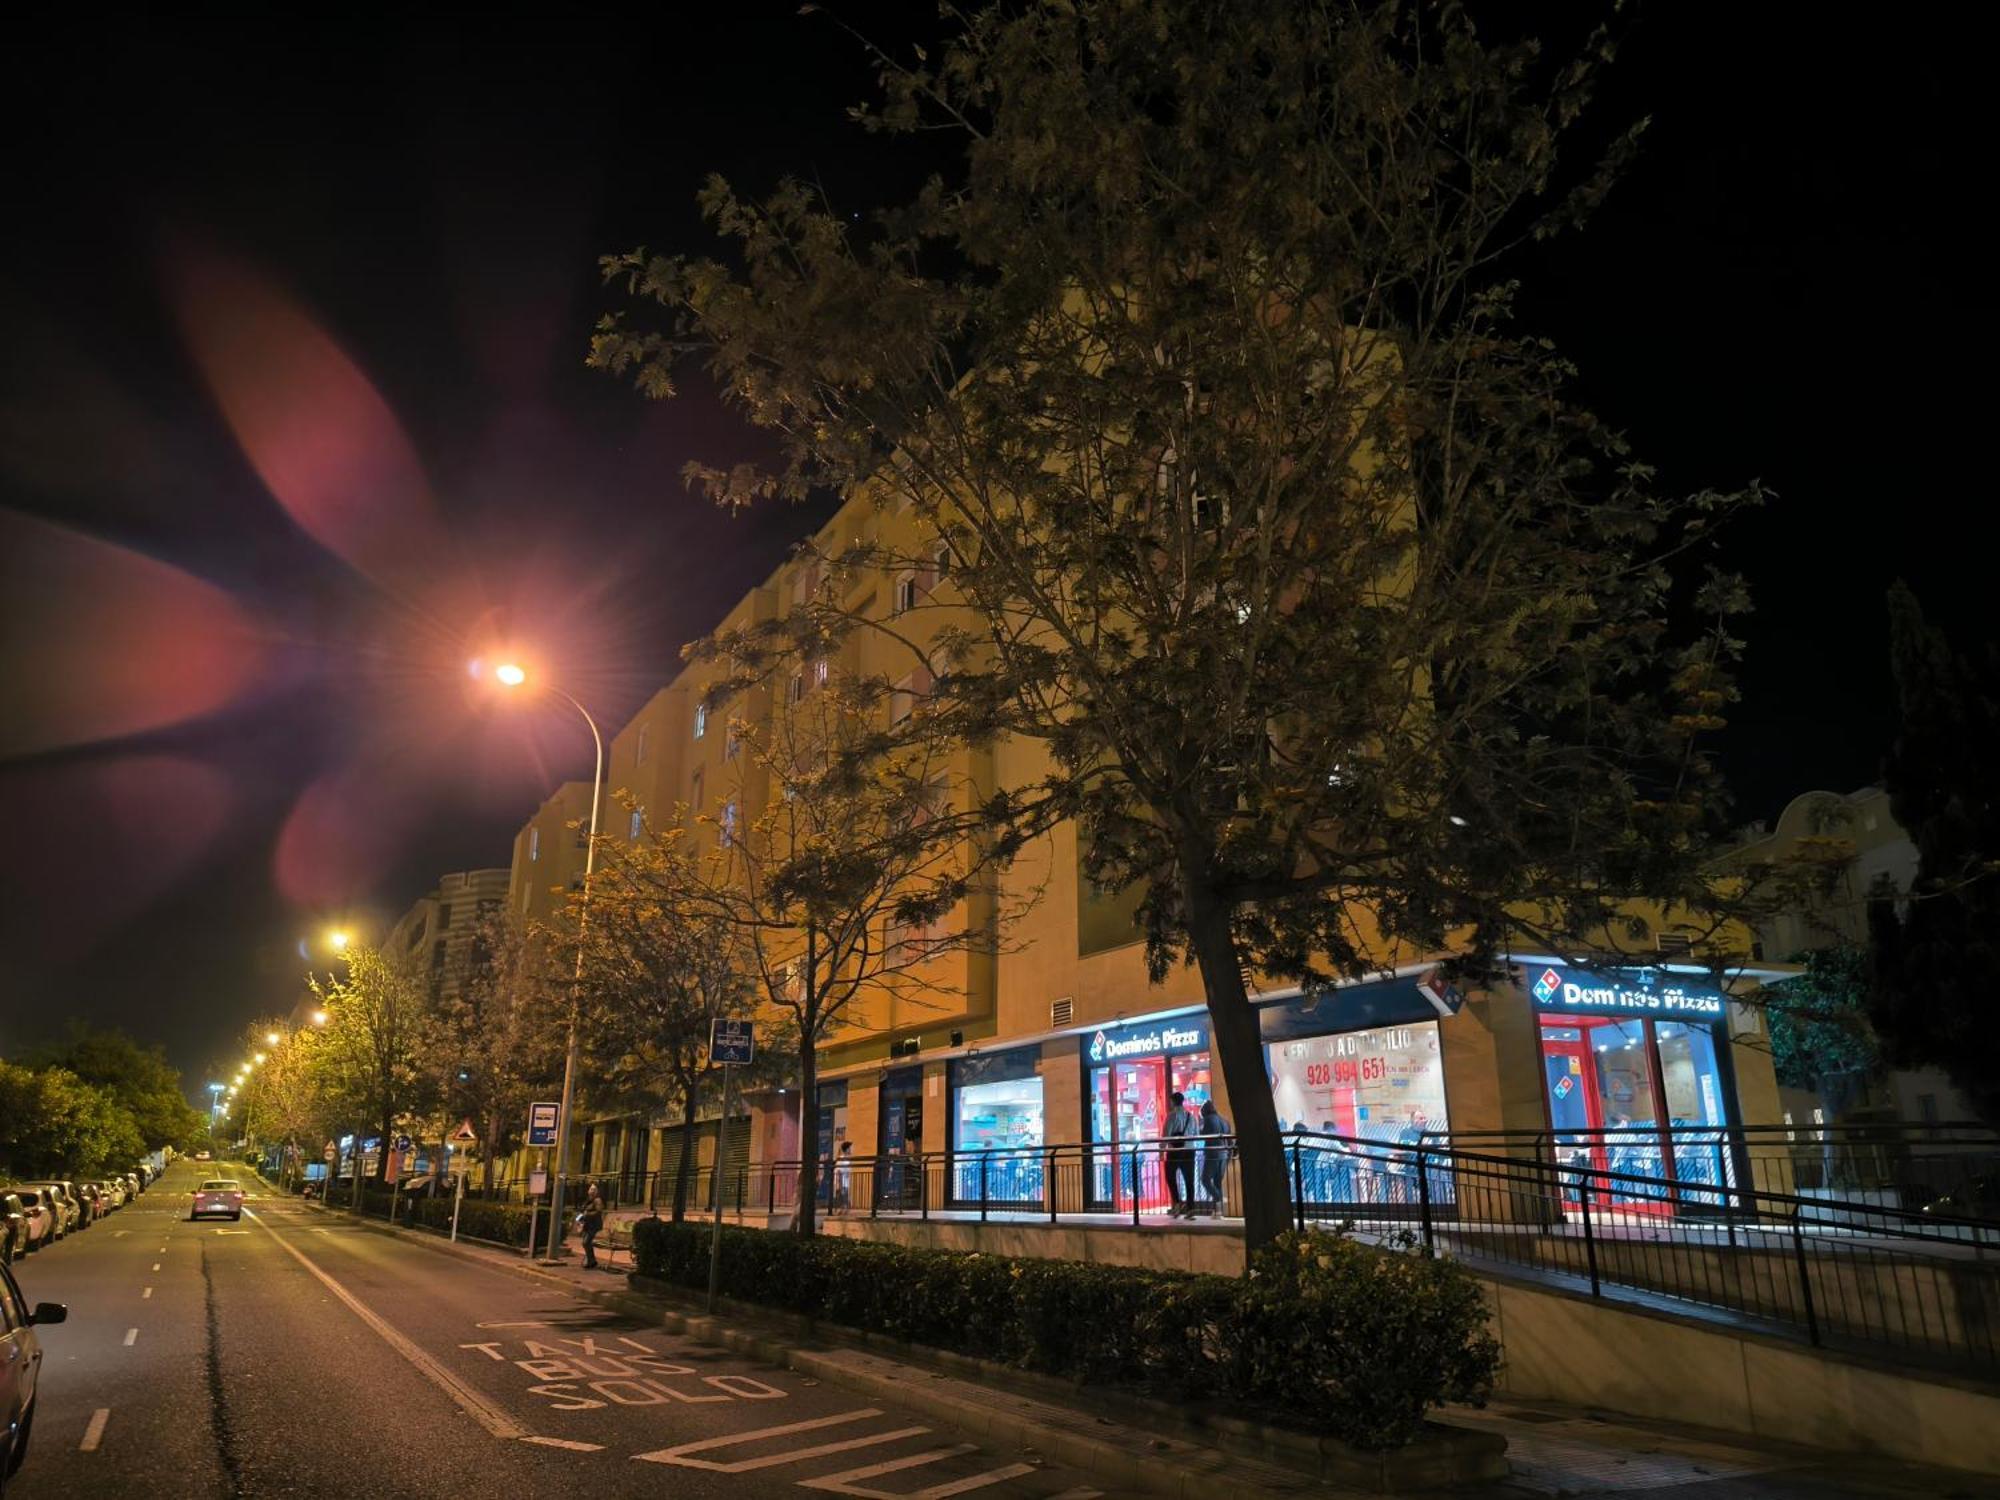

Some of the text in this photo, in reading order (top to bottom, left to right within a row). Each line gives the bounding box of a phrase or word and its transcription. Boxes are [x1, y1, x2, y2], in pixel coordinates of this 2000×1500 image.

[1664, 988, 1720, 1012] Pizza
[1105, 1027, 1200, 1058] Domino's Pizza
[1307, 1056, 1386, 1086] 928 994 651
[458, 1336, 657, 1361] TAXI
[513, 1354, 698, 1382] BUS
[527, 1374, 790, 1410] SOLO
